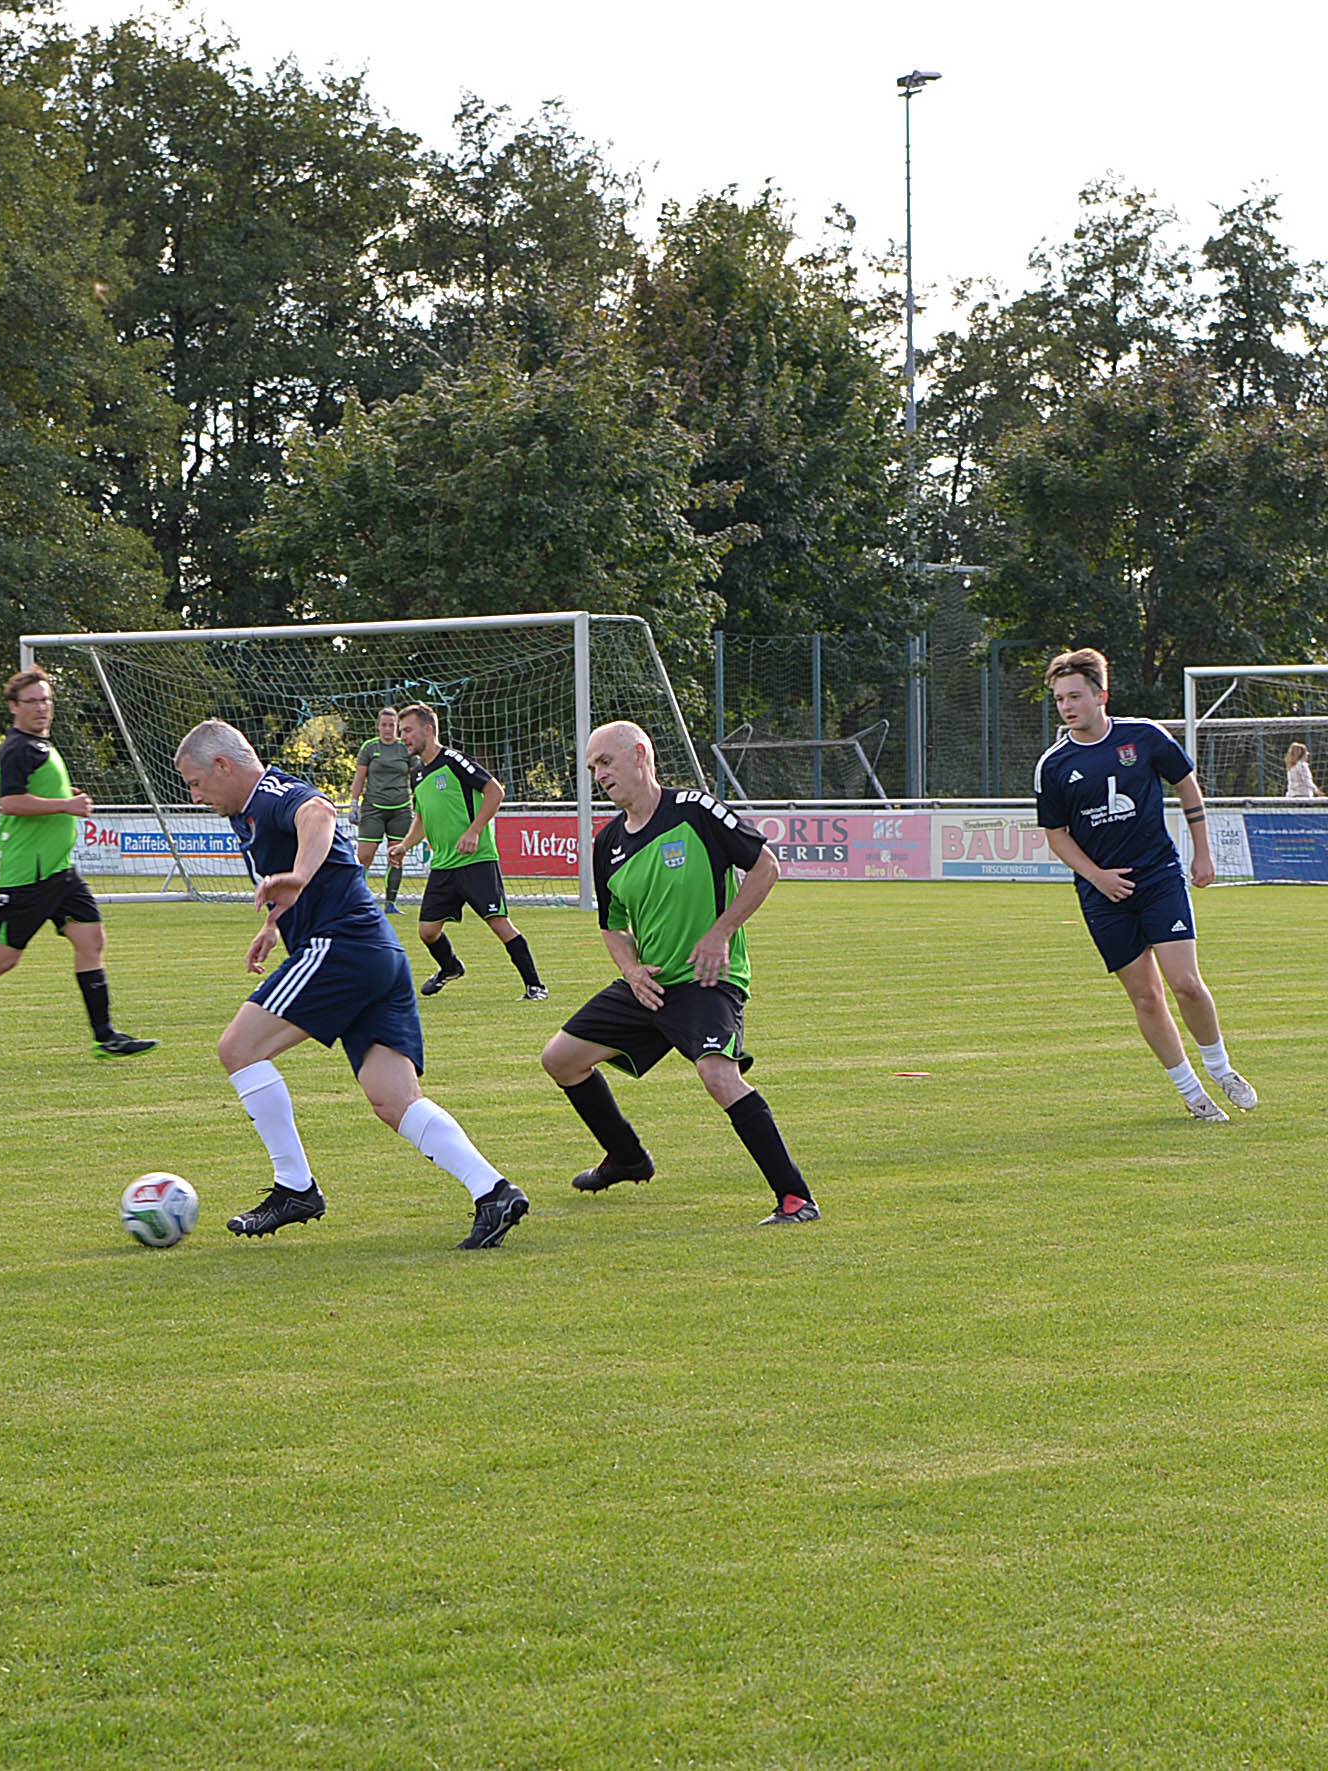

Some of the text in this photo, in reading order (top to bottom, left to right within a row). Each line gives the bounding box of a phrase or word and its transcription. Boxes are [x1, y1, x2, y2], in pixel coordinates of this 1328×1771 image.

[209, 834, 223, 850] im
[227, 834, 240, 851] St
[520, 830, 579, 865] Metzg
[941, 826, 1059, 862] BAUP
[981, 864, 1039, 874] TIRSCHENREUTH
